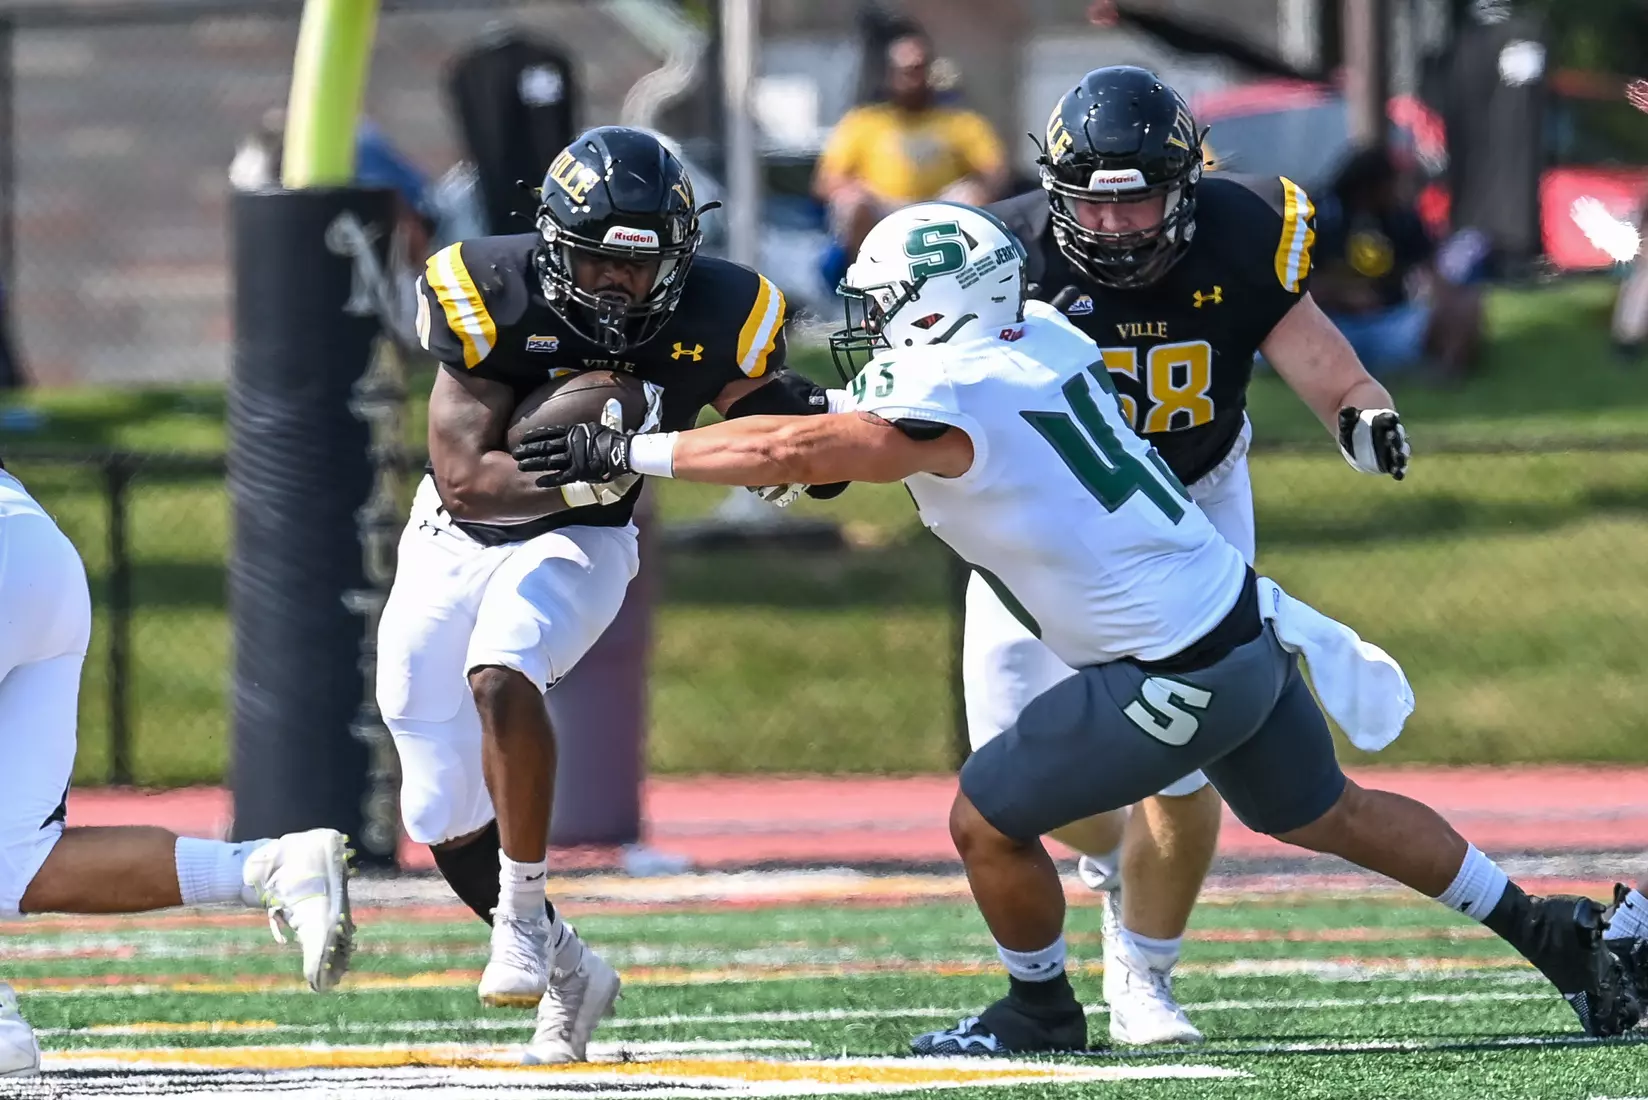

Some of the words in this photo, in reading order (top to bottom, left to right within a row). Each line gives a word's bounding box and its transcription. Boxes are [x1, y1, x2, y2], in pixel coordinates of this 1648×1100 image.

[614, 232, 653, 244] Riddell
[903, 221, 967, 282] S
[529, 339, 557, 348] PSAC
[1116, 320, 1168, 339] VILLE
[1018, 360, 1193, 526] 4
[1122, 675, 1214, 748] S
